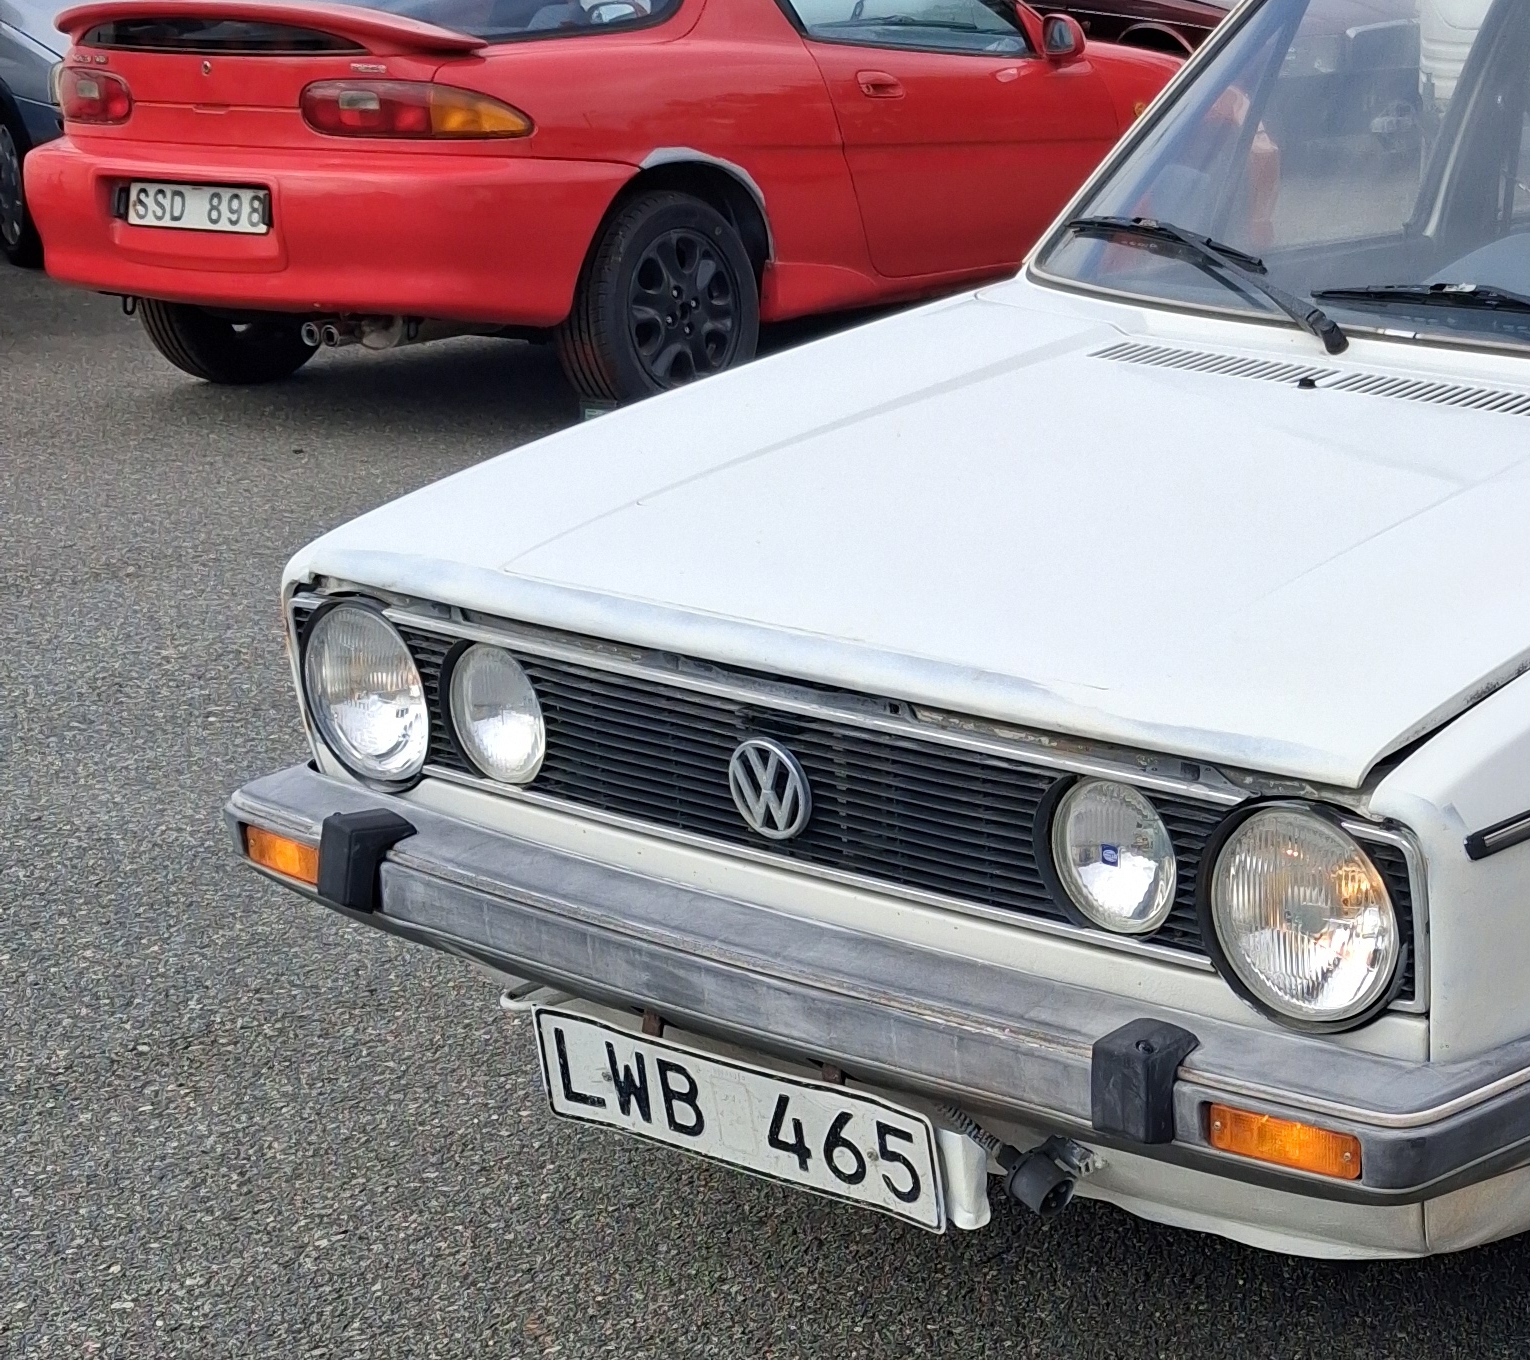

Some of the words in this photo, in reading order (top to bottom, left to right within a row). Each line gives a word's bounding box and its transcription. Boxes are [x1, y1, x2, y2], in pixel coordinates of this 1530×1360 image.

[134, 187, 186, 222] SSD
[207, 191, 264, 228] 898
[553, 1026, 706, 1137] LWB
[767, 1092, 923, 1204] 465
